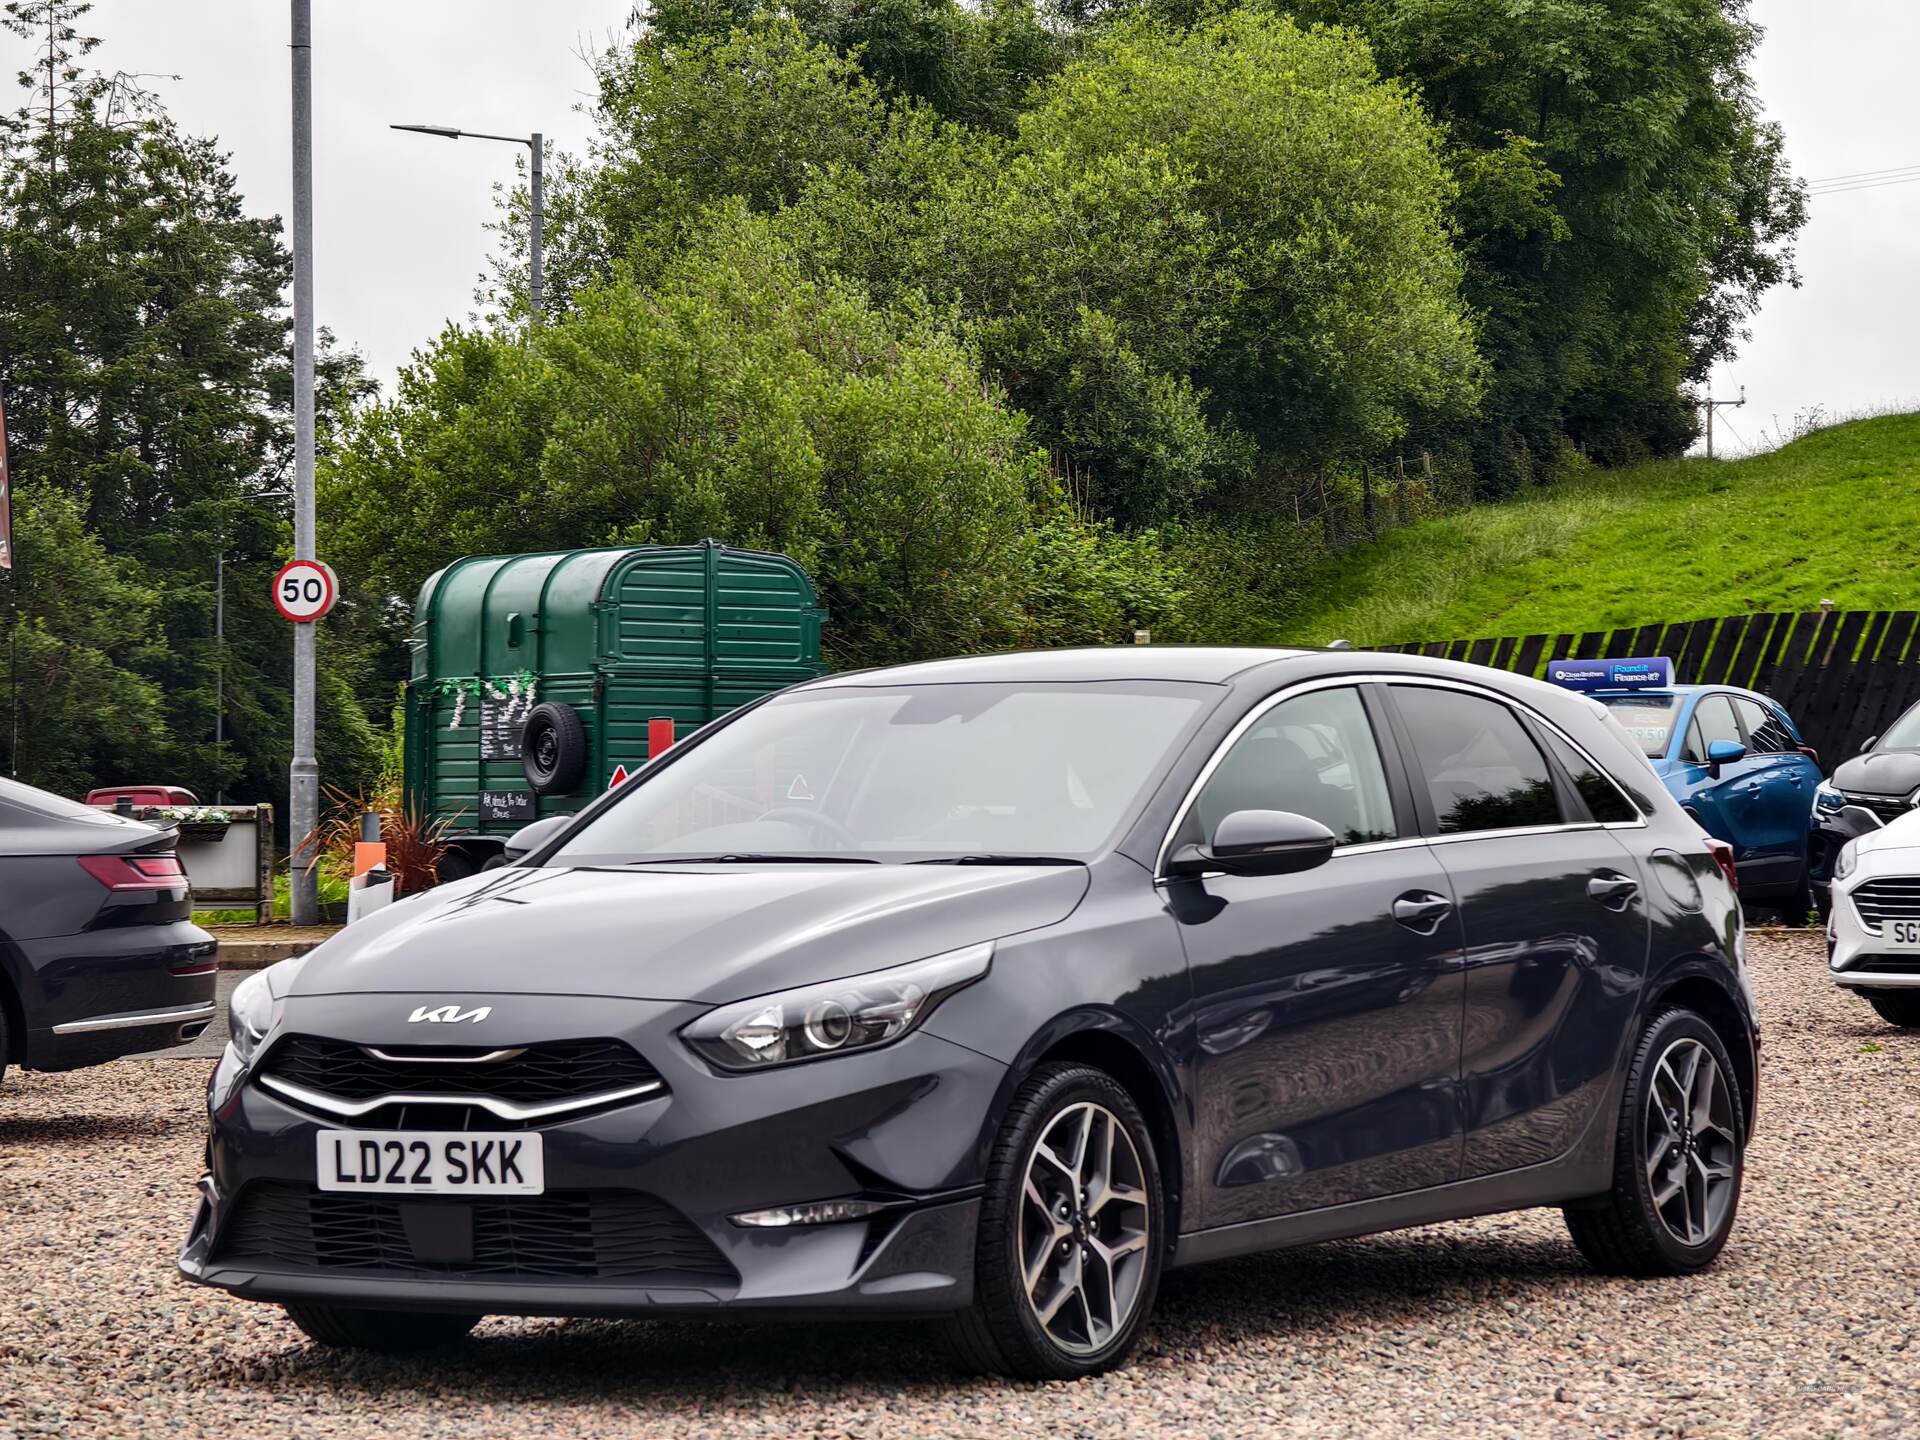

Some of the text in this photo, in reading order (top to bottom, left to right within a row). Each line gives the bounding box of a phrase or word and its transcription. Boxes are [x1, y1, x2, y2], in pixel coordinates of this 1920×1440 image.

[283, 578, 322, 602] 50
[1614, 673, 1647, 682] Finance
[1894, 922, 1920, 943] SG
[335, 1140, 524, 1184] LD22 SKK
